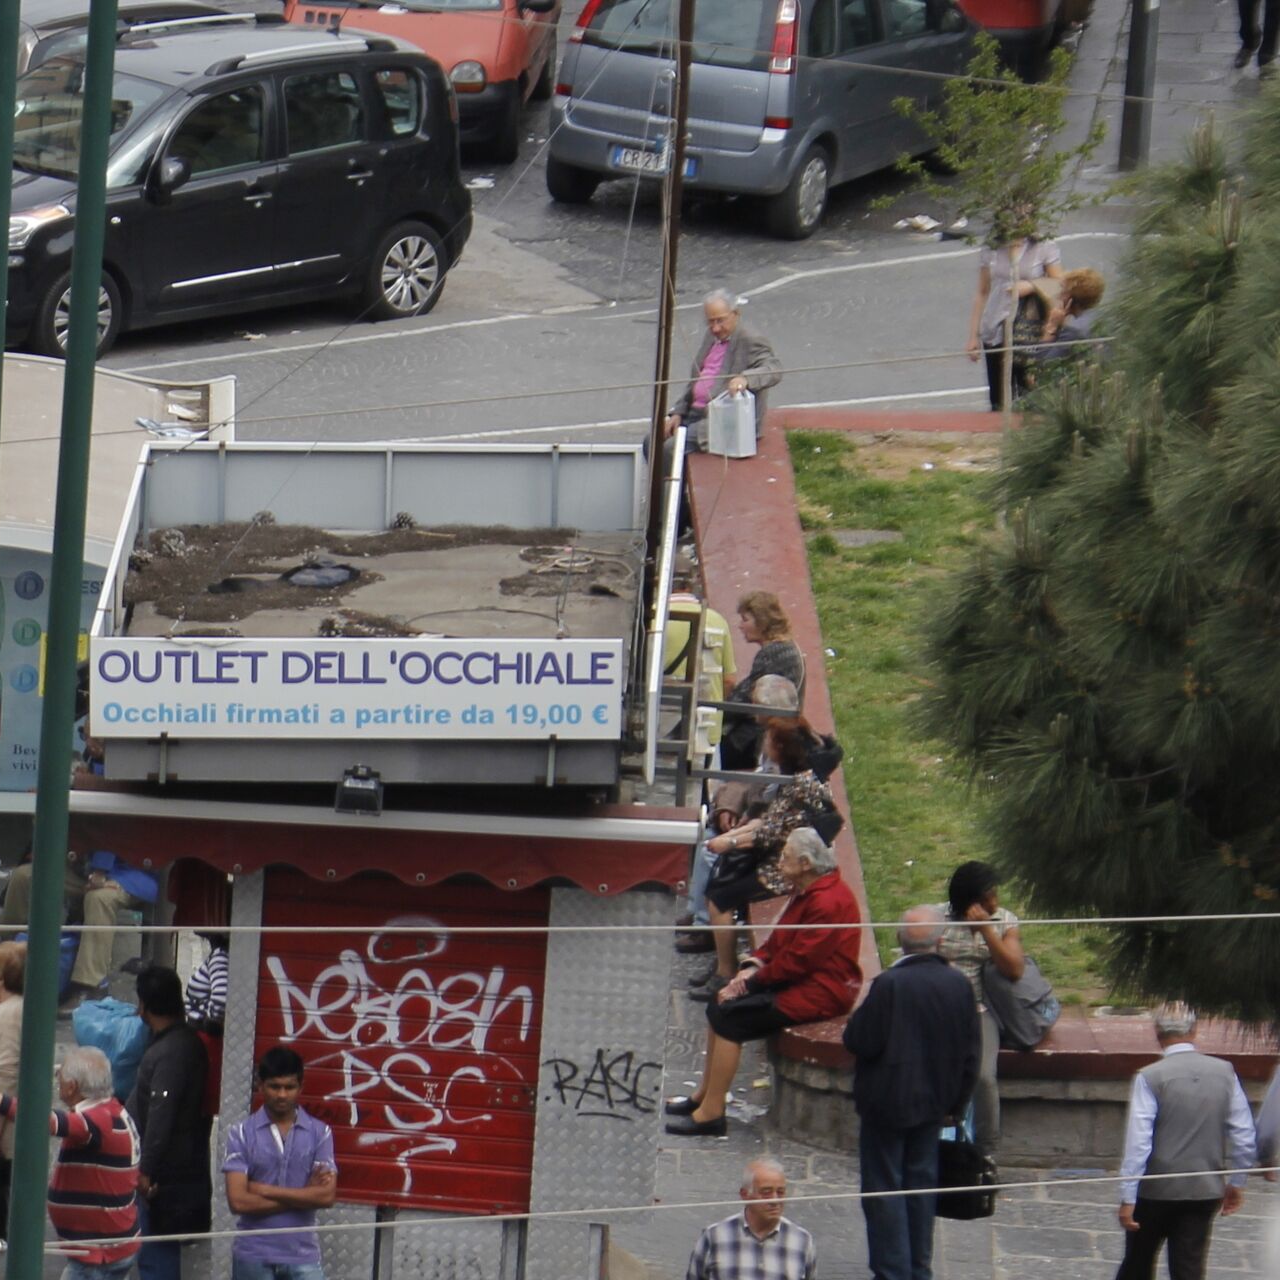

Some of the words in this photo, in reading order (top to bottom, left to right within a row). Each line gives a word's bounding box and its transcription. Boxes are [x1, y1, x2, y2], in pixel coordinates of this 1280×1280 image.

[98, 650, 269, 684] OUTLET
[282, 650, 615, 685] DELL'OCCHIALE
[103, 702, 217, 724] Occhiali
[226, 703, 320, 724] firmati
[329, 707, 346, 724] a
[355, 704, 452, 729] partire
[461, 704, 495, 725] da
[505, 704, 582, 729] 19,00
[592, 704, 610, 725] €
